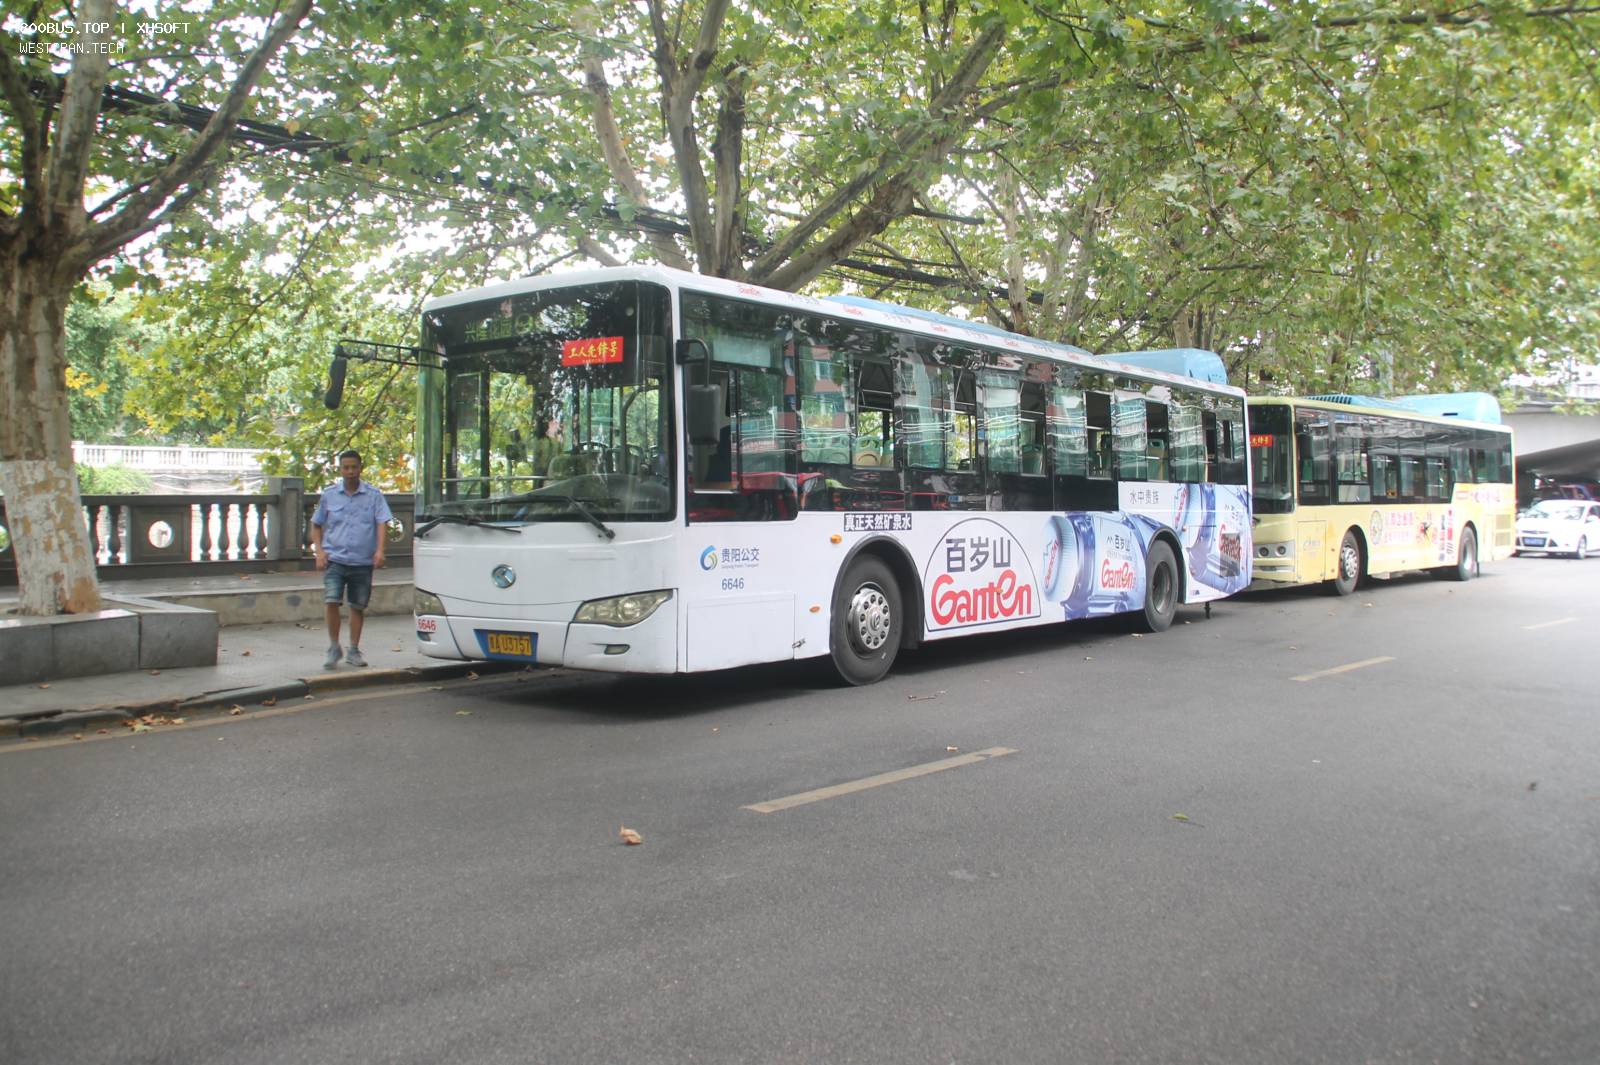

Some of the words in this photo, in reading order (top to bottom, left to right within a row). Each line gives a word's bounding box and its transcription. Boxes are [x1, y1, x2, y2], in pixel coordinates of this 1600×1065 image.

[845, 513, 911, 531] 真正天然矿泉水
[721, 547, 760, 563] 贵阳公交
[945, 537, 1012, 573] 百岁山
[1101, 558, 1134, 590] Ganten
[721, 577, 744, 591] 6646
[930, 569, 1032, 626] Ganten
[417, 618, 437, 631] 6646
